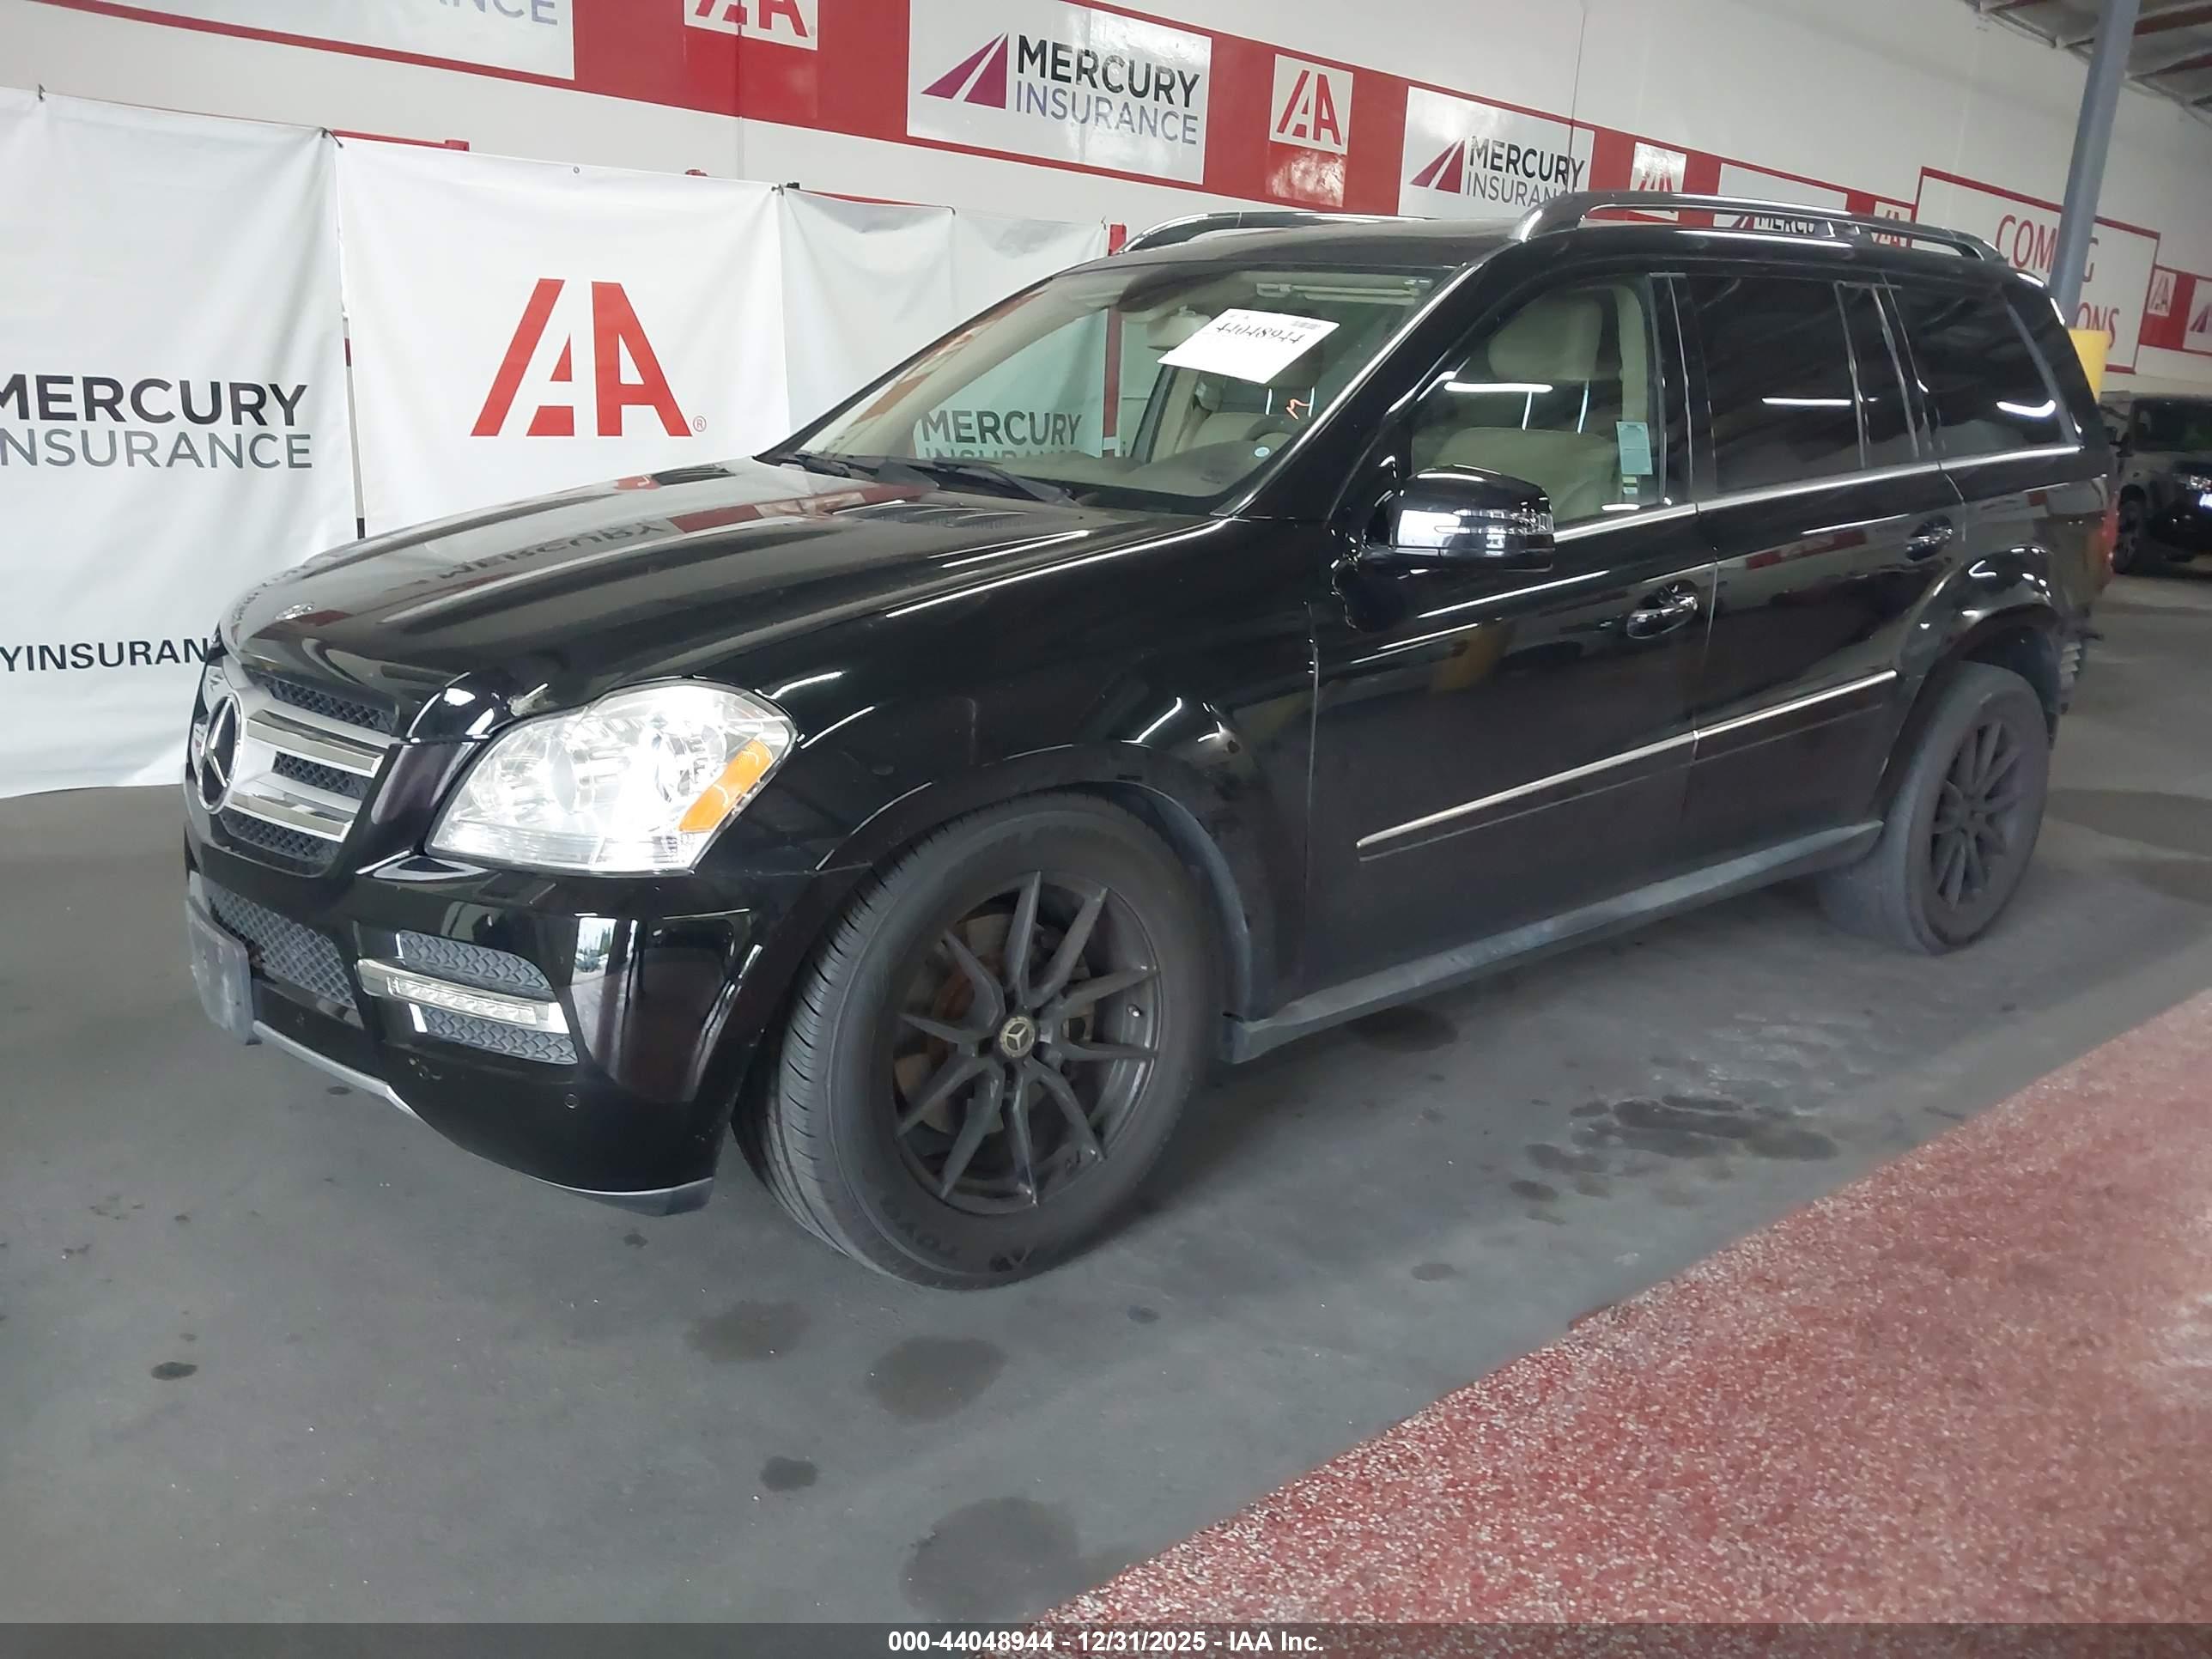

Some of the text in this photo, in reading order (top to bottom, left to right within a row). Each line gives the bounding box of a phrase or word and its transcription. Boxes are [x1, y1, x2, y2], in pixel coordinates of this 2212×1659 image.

[1017, 33, 1200, 108] MERCURY
[1016, 80, 1199, 145] INSURANCE
[1469, 136, 1585, 189] MERCURY
[921, 409, 1083, 447] MERCURY
